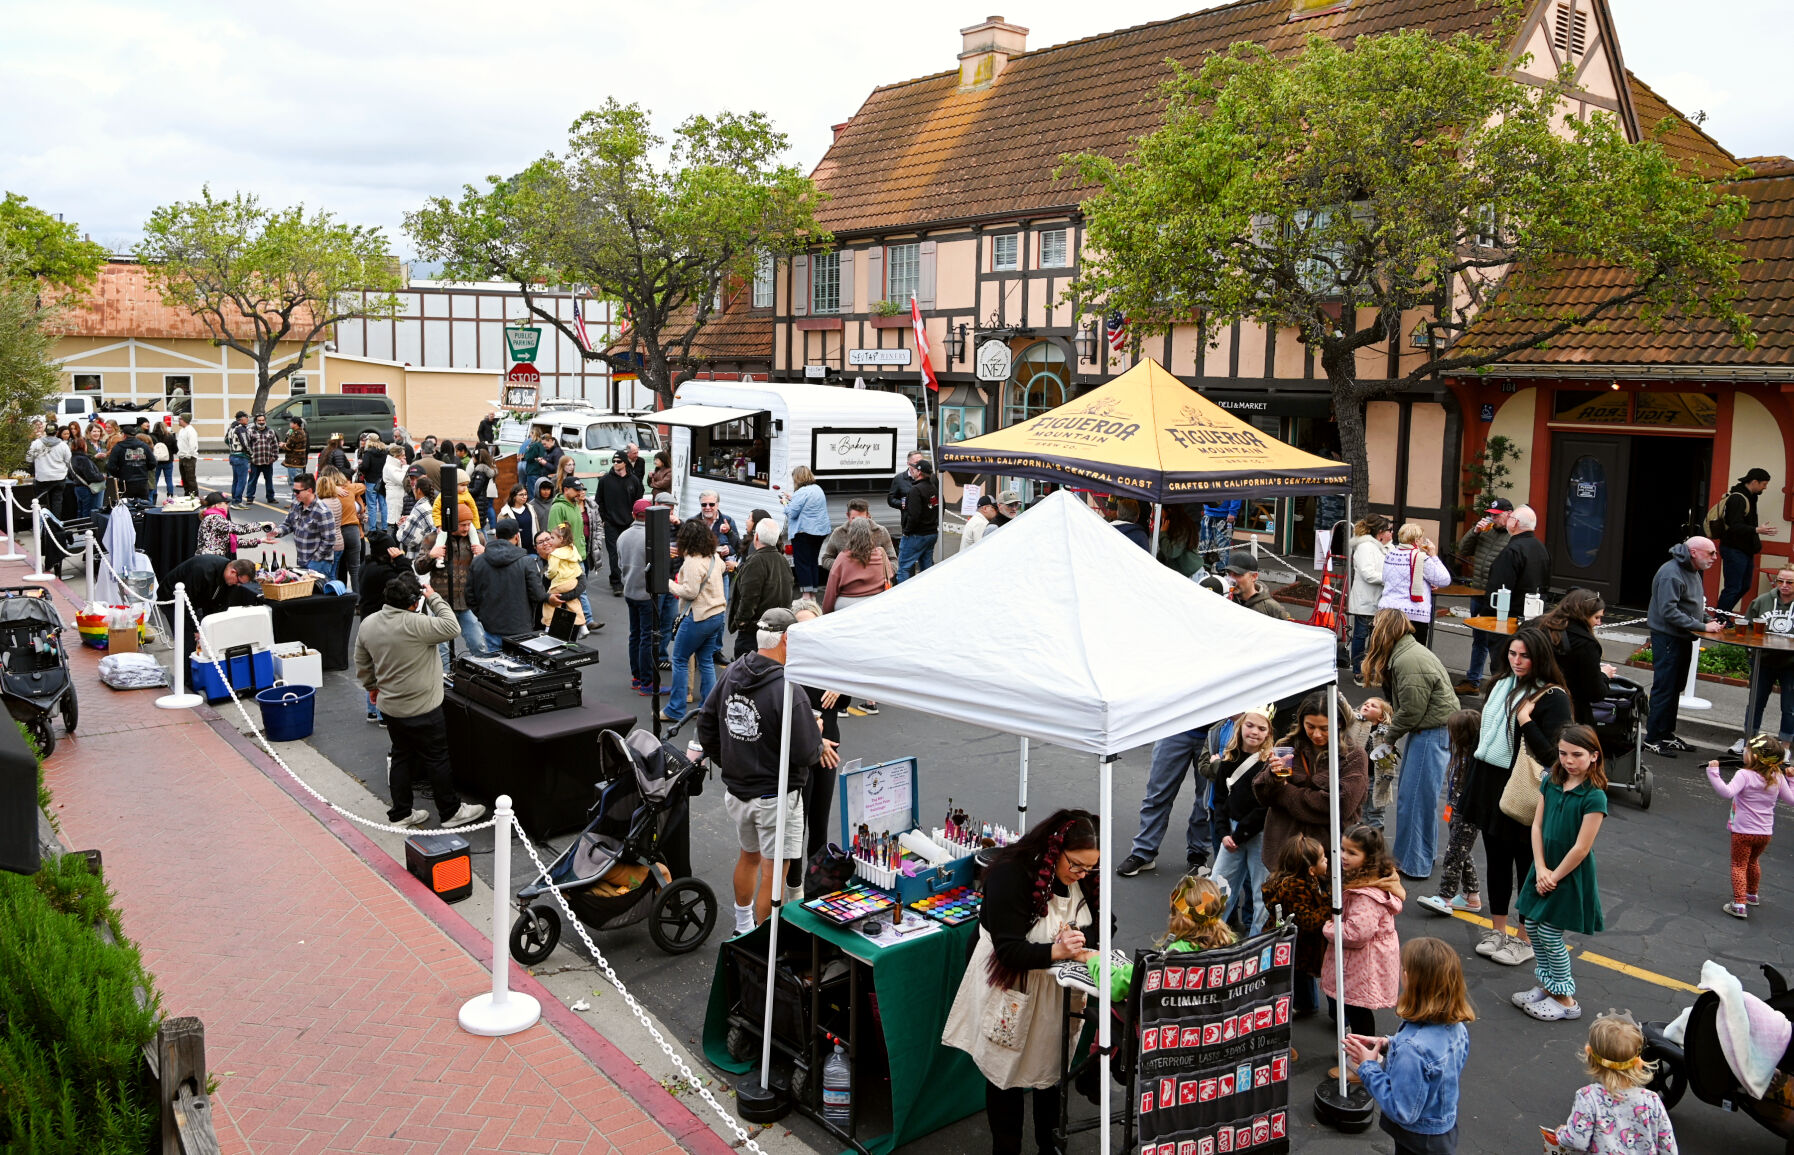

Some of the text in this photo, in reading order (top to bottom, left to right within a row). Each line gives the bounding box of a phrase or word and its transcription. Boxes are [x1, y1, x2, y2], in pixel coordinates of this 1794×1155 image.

[880, 352, 907, 360] WINERY
[982, 363, 1007, 377] INEZ
[510, 373, 539, 382] STOP
[1502, 383, 1516, 393] 104
[1239, 402, 1267, 410] MARKET
[1026, 416, 1141, 441] FIGUEROA
[1033, 431, 1108, 443] MOUNTAIN
[1164, 428, 1268, 449] FIGUEROA
[838, 435, 872, 456] Bakery
[944, 453, 1153, 489] CRAFTED IN CALIFORNIA'S CENTRAL COAST
[1168, 476, 1348, 491] CRAFTED IN CALIFORNIA'S CENTRAL COAST
[1161, 976, 1267, 1007] GLIMMER TATTOOS
